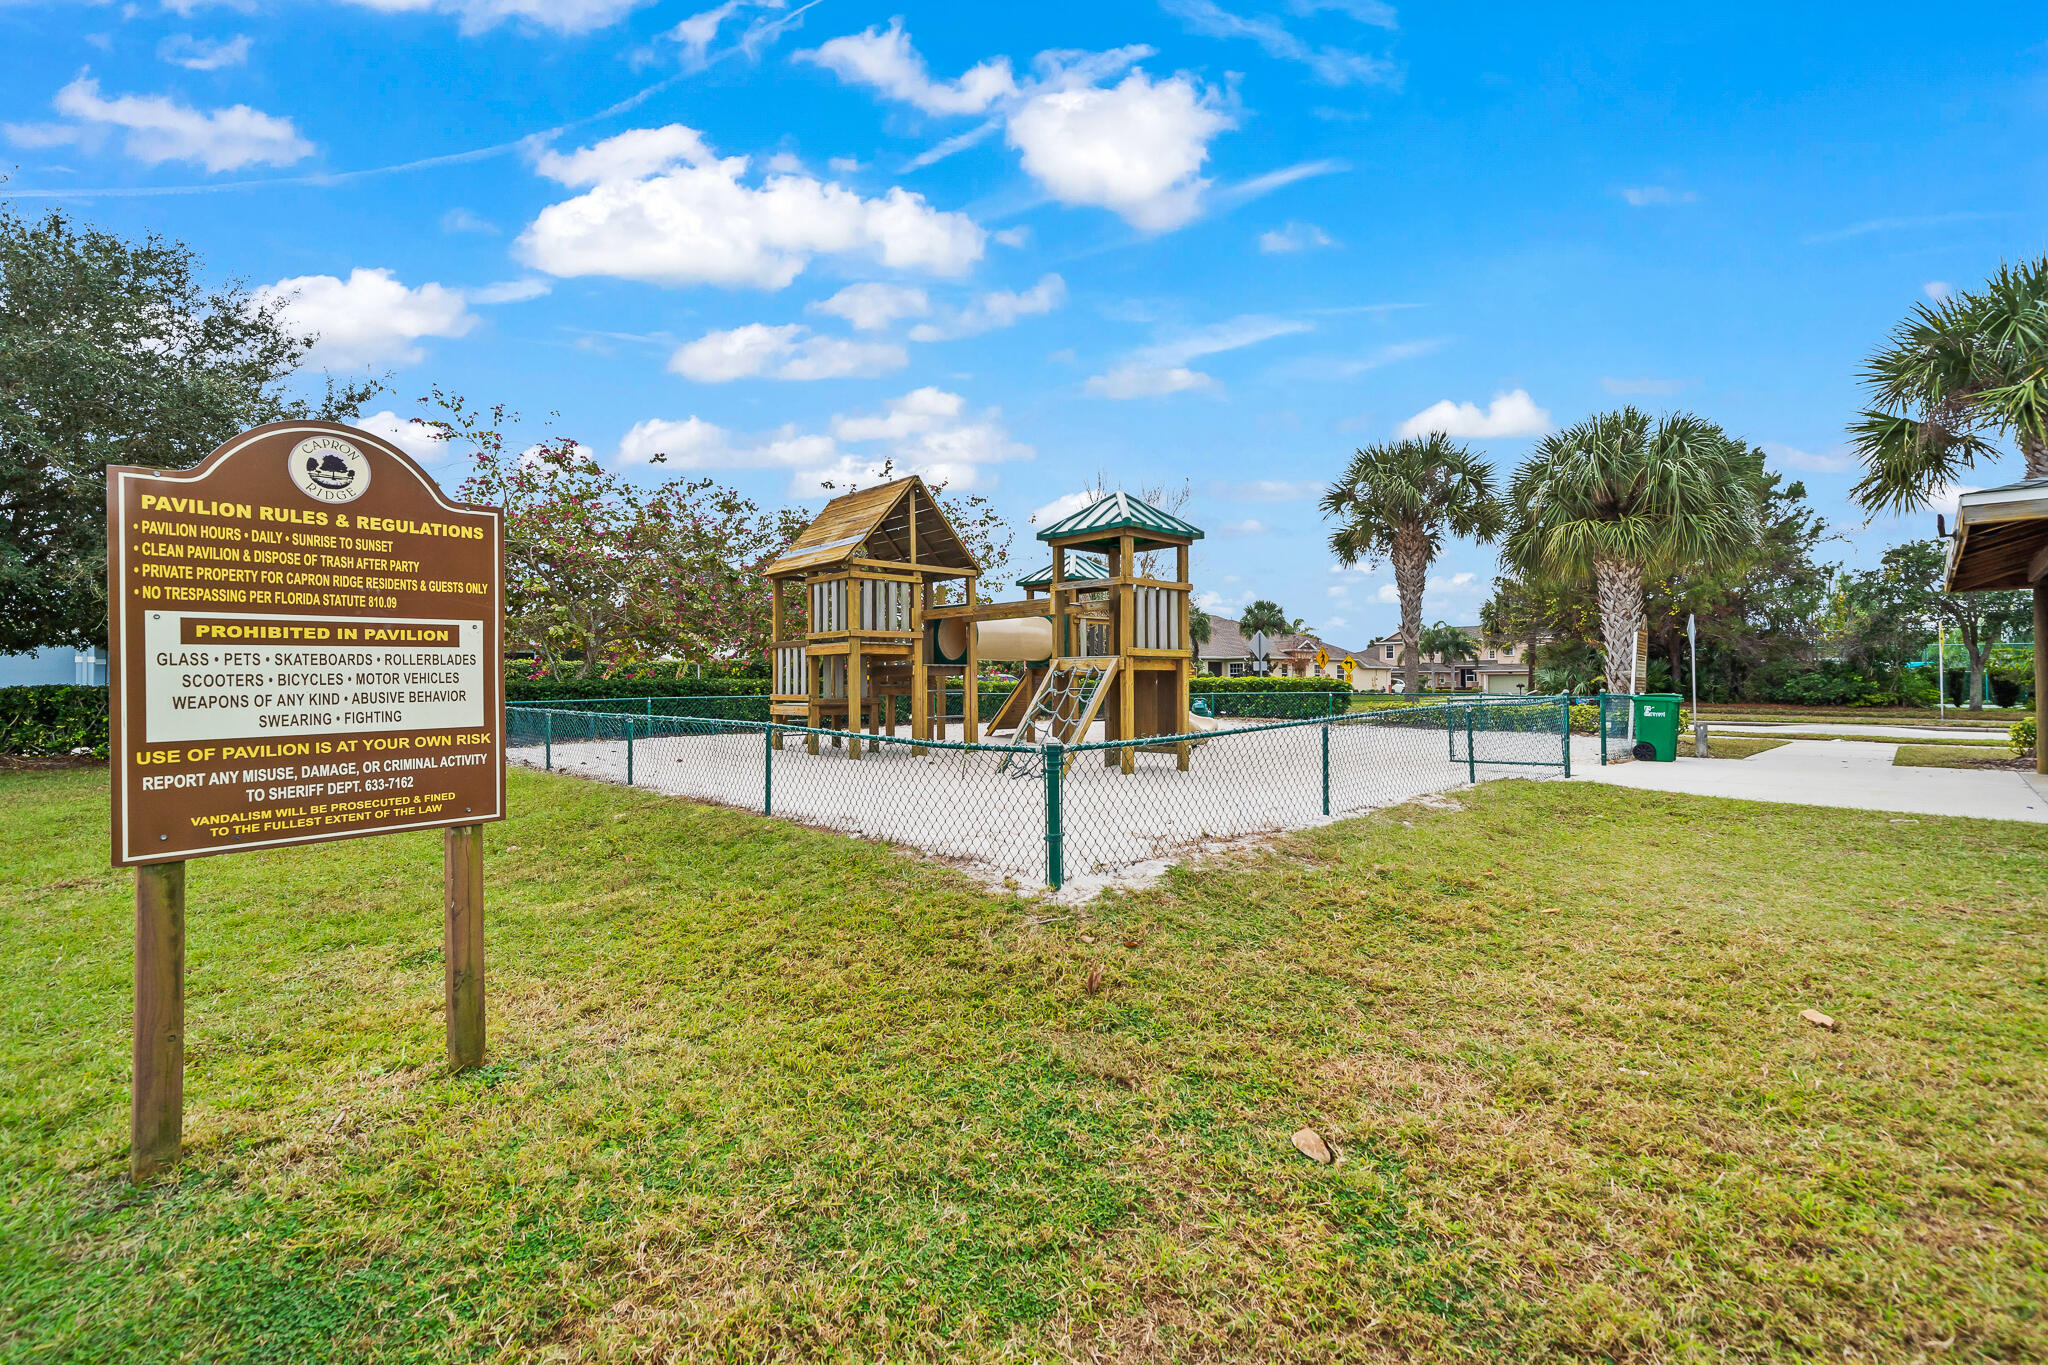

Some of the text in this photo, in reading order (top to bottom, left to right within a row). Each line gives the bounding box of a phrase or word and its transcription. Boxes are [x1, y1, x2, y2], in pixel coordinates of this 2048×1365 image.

[302, 439, 359, 460] CAPRON
[306, 483, 356, 500] RIDGE
[142, 495, 484, 539] PAVILION RULES & REGULATIONS
[142, 520, 393, 552] PAVILION HOURS DAILY SUNRISE TO SUNSET
[142, 542, 419, 572] CLEAN PAVILION & DISPOSE OF TRASH AFTER PARTY
[142, 564, 488, 594] PRIVATE PROPERTY FOR CAPRON RIDGE RESIDENTS & GUESTS ONLY
[142, 586, 397, 608] NO TRESPASSING PER FLORIDA STATUTE 810.09
[196, 625, 448, 641] PROHIBITED IN PAVILION
[157, 653, 476, 665] GLASS PETS SKATEBOARDS ROLLERBLADES
[183, 673, 459, 687] SCOOTERS BICYCLES MOTOR VEHICLES
[172, 691, 466, 709] WEAPONS OF ANY KIND ABUSIVE BEHAVIOR
[259, 711, 401, 727] SWEARING FIGHTING
[137, 733, 491, 765] USE OF PAVILION IS AT YOUR OWN RISK
[142, 753, 487, 790] REPORT ANY MISUSE, DAMAGE, OR CRIMINAL ACTIVITY
[246, 776, 413, 802] TO SHERIFF DEPT. 633-7162
[191, 810, 272, 826] VANDALISM
[275, 807, 307, 817] WILL
[310, 804, 327, 814] BE
[331, 797, 410, 812] PROSECUTED
[424, 792, 455, 802] FINED
[210, 804, 442, 837] TO THE FULLEST EXTENT OF THE LAW
